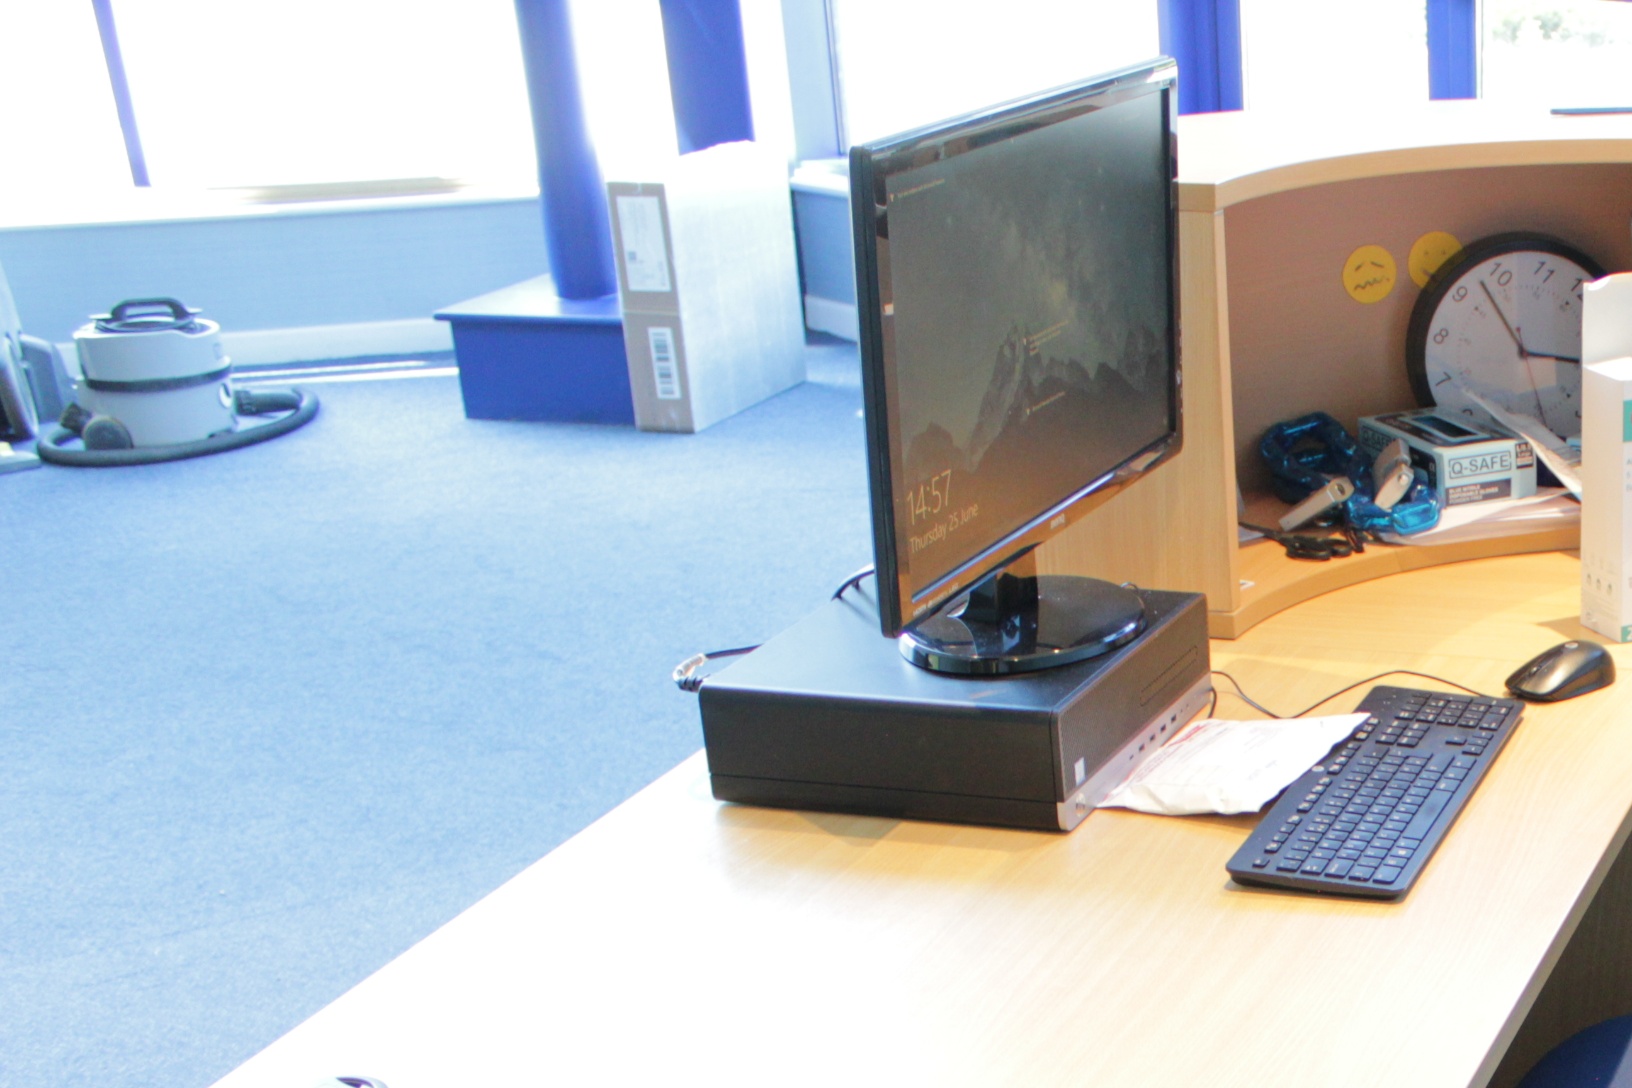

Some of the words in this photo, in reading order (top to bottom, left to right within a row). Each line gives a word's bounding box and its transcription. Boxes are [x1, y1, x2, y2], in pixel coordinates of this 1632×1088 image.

[1490, 262, 1513, 287] 10
[1534, 261, 1555, 284] 11
[1452, 286, 1468, 302] 9
[1433, 328, 1449, 344] 8
[1435, 371, 1452, 386] 7
[1451, 454, 1510, 475] Q-SAFE
[907, 469, 951, 525] 14:57
[909, 522, 947, 553] Thursday
[949, 514, 958, 531] 25
[960, 504, 979, 525] June
